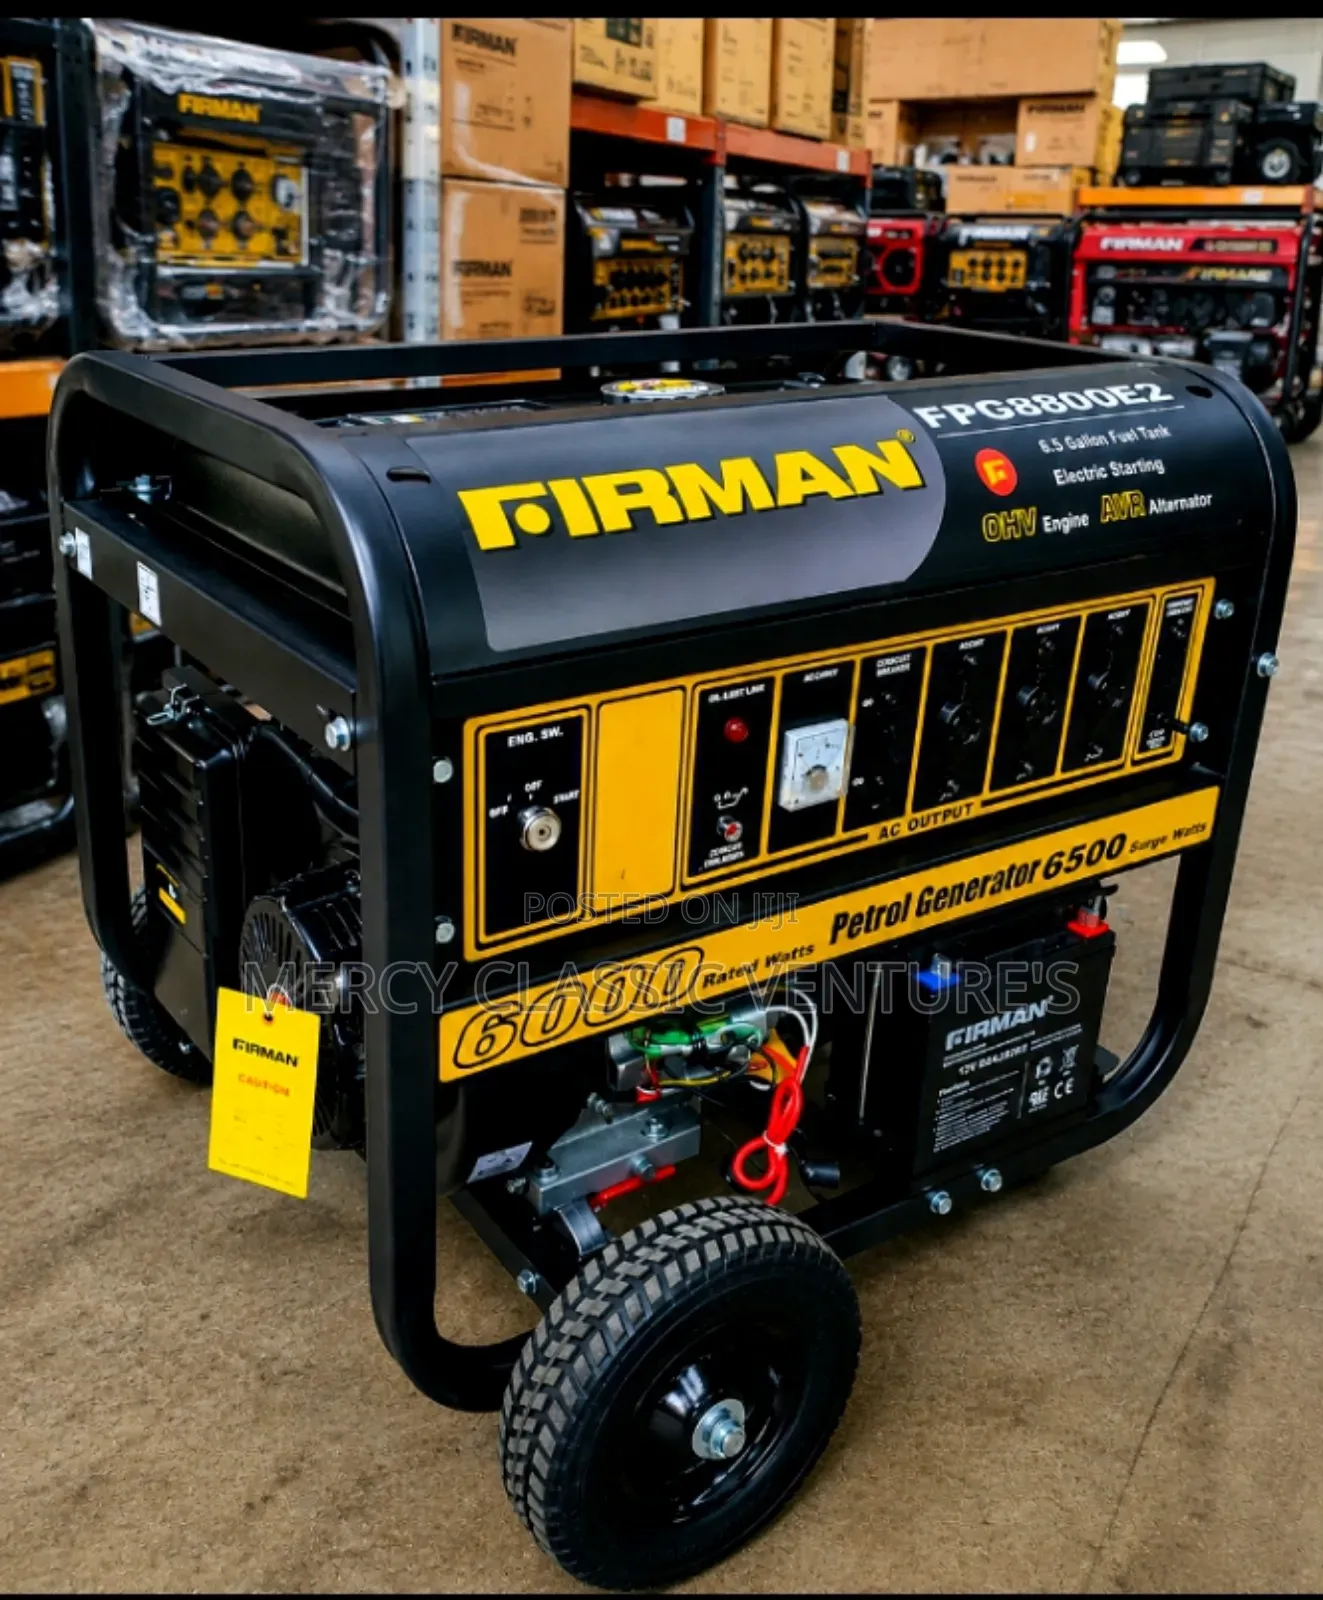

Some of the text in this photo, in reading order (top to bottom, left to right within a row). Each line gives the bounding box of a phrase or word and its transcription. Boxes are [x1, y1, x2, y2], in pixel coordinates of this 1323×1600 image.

[177, 92, 261, 124] FIRMAN
[1099, 237, 1184, 251] FIRMAN
[914, 382, 1175, 429] FPG8800E2
[1038, 423, 1172, 454] 6.5 Gallon Fuel Tank
[1052, 457, 1166, 487] Electric Starting
[457, 438, 927, 551] FIRMAN
[982, 506, 1038, 543] OHV
[1042, 512, 1090, 535] Engine
[1100, 489, 1147, 524] AVR
[507, 725, 565, 749] ENG. SW.
[877, 802, 975, 841] AC OUTPUT
[453, 820, 1208, 1069] 6000 Rated Watts Petrol Generator 6500 Surge Watts
[944, 1000, 1050, 1052] FIRMAN
[232, 1038, 299, 1068] FIRMAN
[237, 1073, 290, 1097] CAUTION
